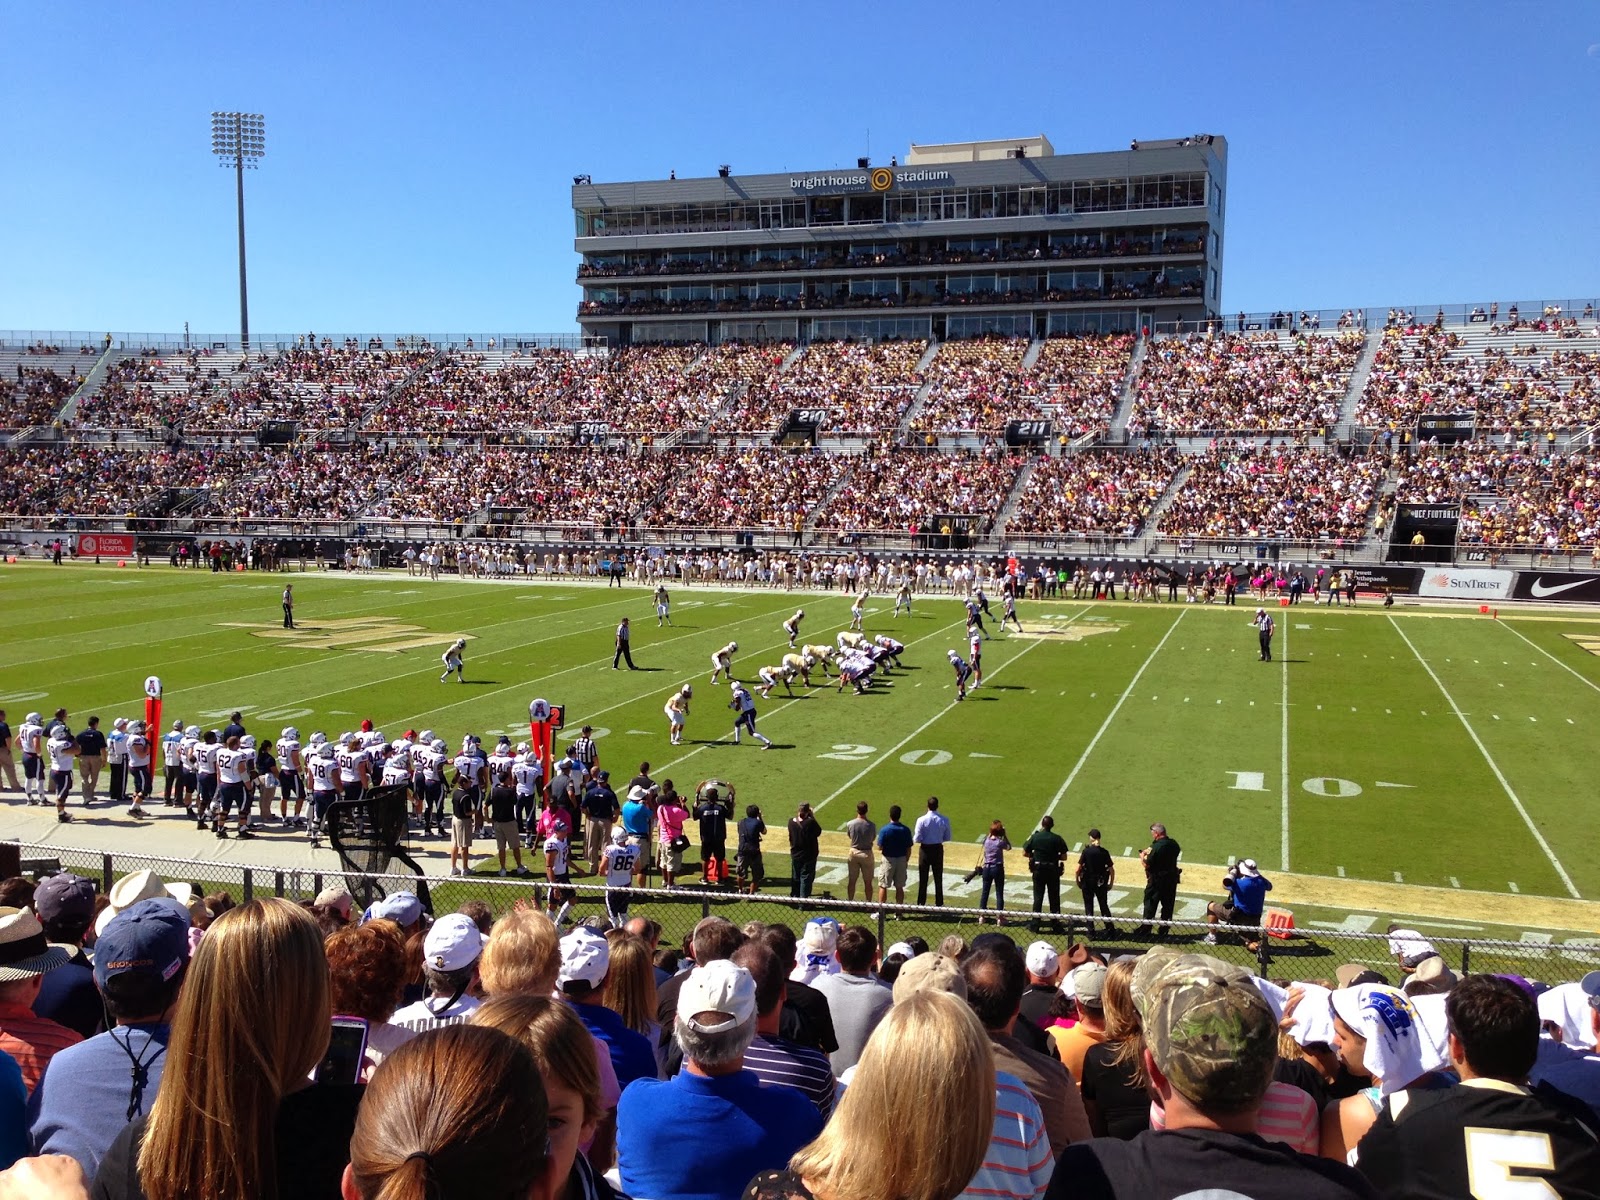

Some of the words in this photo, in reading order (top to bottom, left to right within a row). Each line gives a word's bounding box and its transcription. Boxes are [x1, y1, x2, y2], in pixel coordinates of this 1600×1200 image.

[790, 177, 826, 190] bright
[828, 175, 866, 186] house
[896, 170, 948, 182] stadium
[798, 410, 825, 422] 210
[580, 423, 608, 435] 209
[1018, 421, 1046, 435] 211
[1043, 541, 1056, 549] 112
[1223, 545, 1237, 553] 113
[1468, 552, 1484, 561] 114
[550, 708, 560, 725] 2
[218, 754, 232, 769] 62
[816, 743, 953, 766] 20
[340, 755, 353, 769] 60
[422, 757, 434, 772] 24
[463, 763, 471, 775] 7
[490, 762, 503, 775] 84
[312, 763, 325, 778] 78
[1225, 771, 1363, 797] 10
[613, 855, 634, 871] 86
[1269, 913, 1287, 928] 10
[107, 959, 154, 969] BRONCOS
